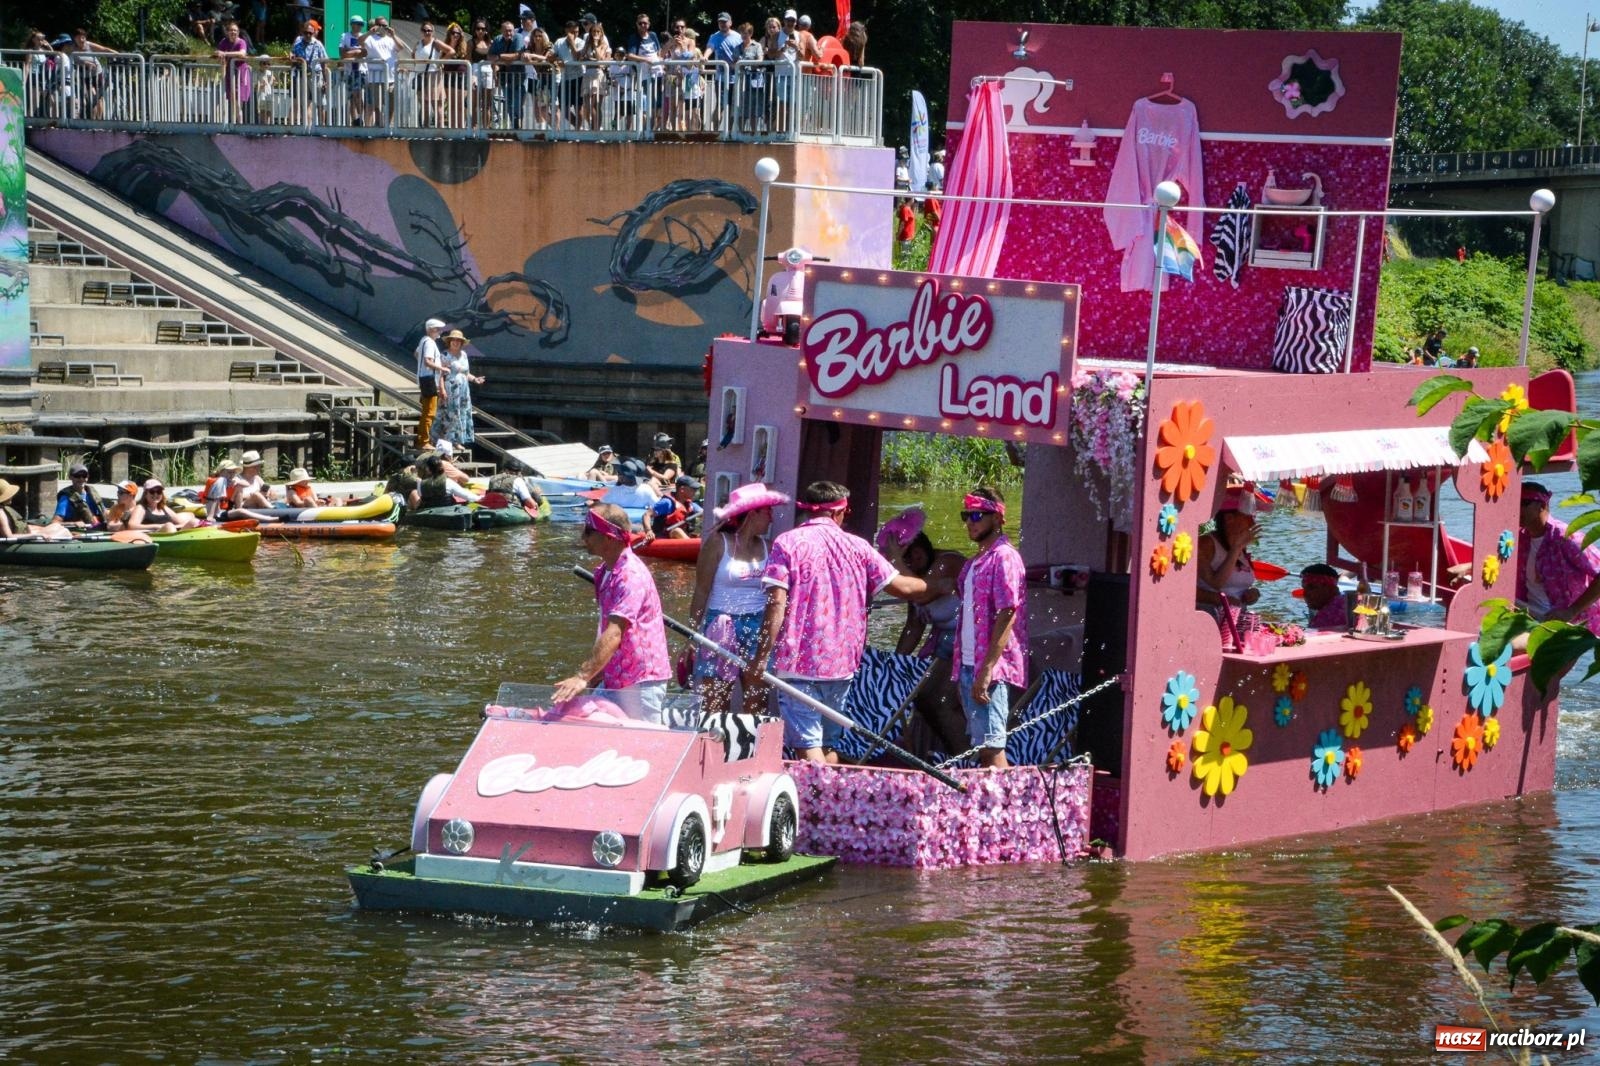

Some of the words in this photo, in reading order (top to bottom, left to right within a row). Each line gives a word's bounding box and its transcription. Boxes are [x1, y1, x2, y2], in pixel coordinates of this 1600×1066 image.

[1138, 127, 1178, 148] Barbie
[806, 281, 987, 394] Barbie
[941, 364, 1053, 425] Land
